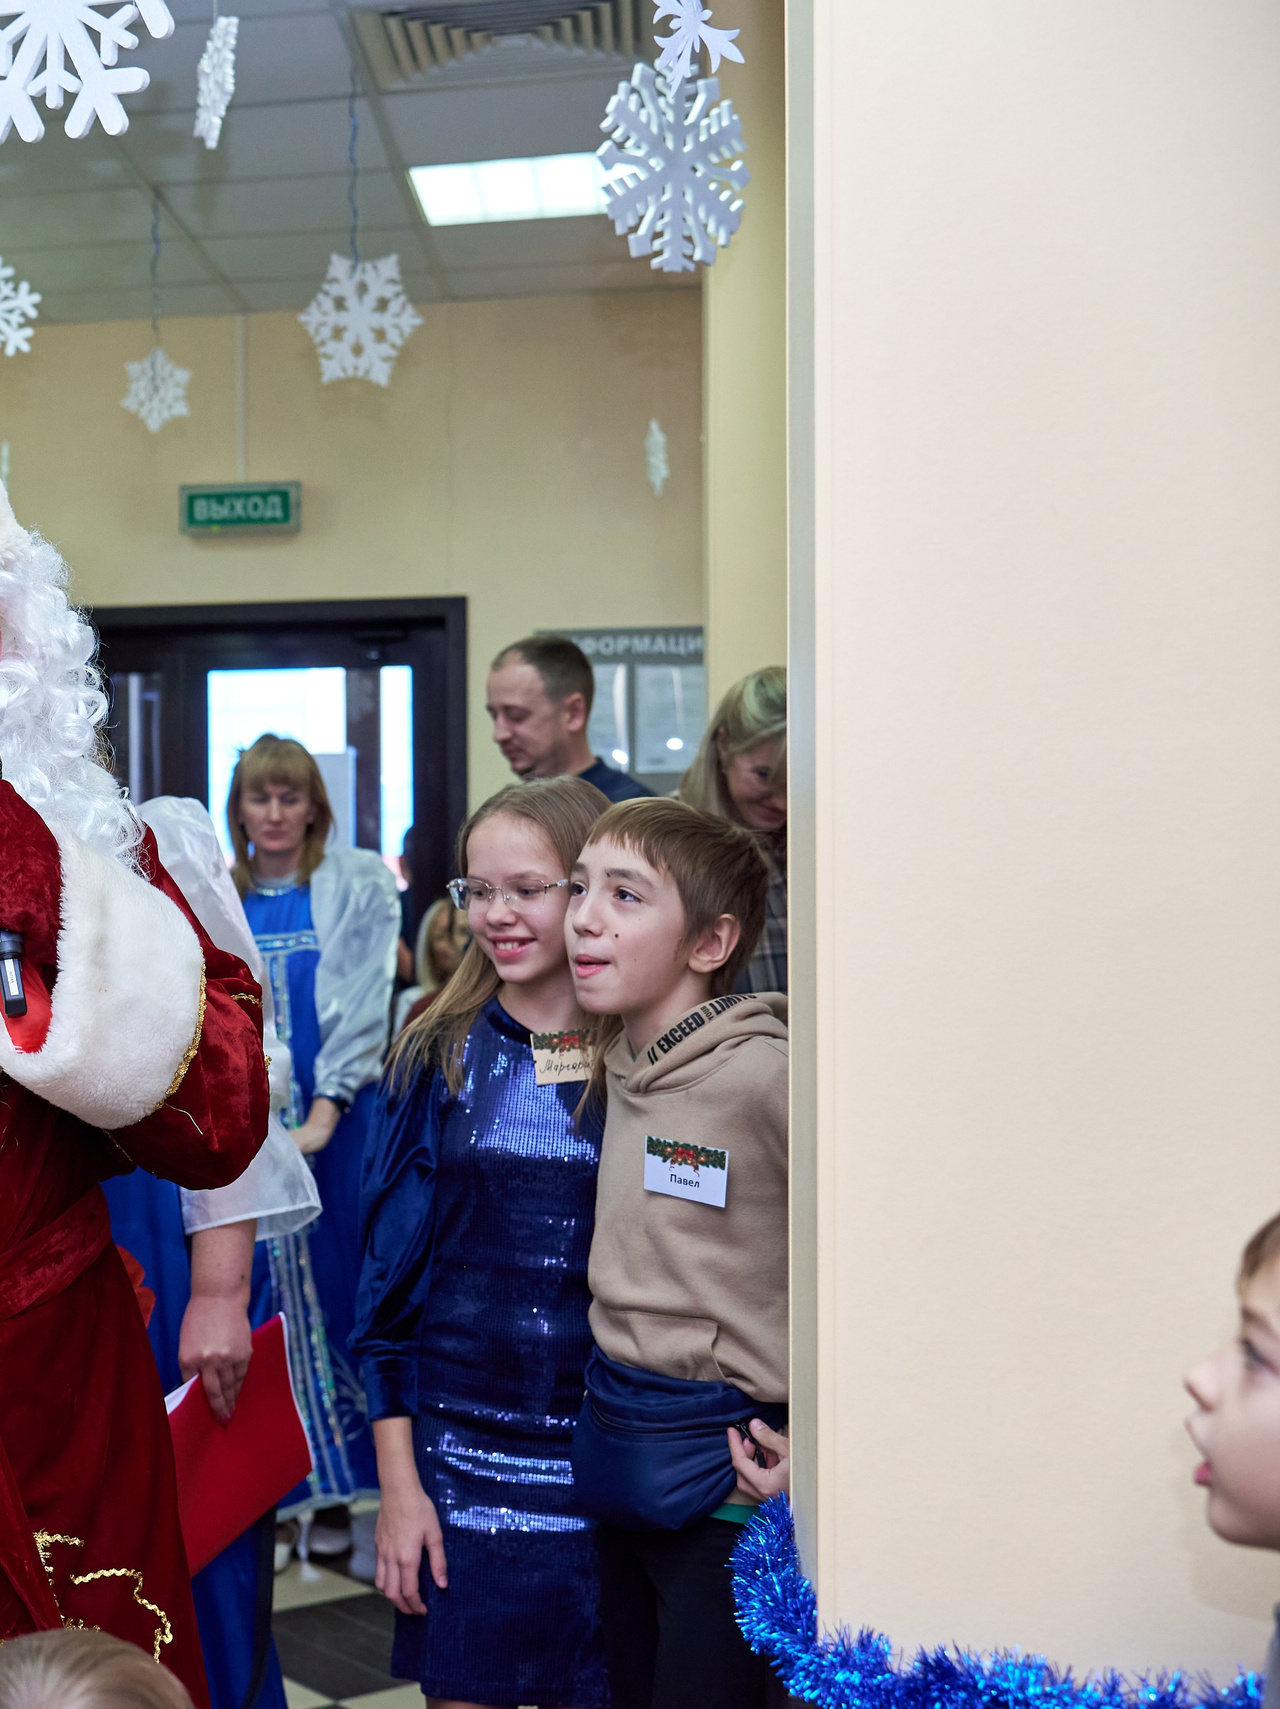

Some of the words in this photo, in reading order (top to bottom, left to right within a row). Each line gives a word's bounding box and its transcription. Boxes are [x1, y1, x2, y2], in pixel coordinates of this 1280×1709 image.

[193, 495, 284, 520] ВЫХОД
[575, 634, 703, 656] ФОРМАЦИ
[656, 1011, 706, 1055] EXCEED
[539, 1059, 590, 1076] Маргари
[670, 1173, 700, 1188] Павел
